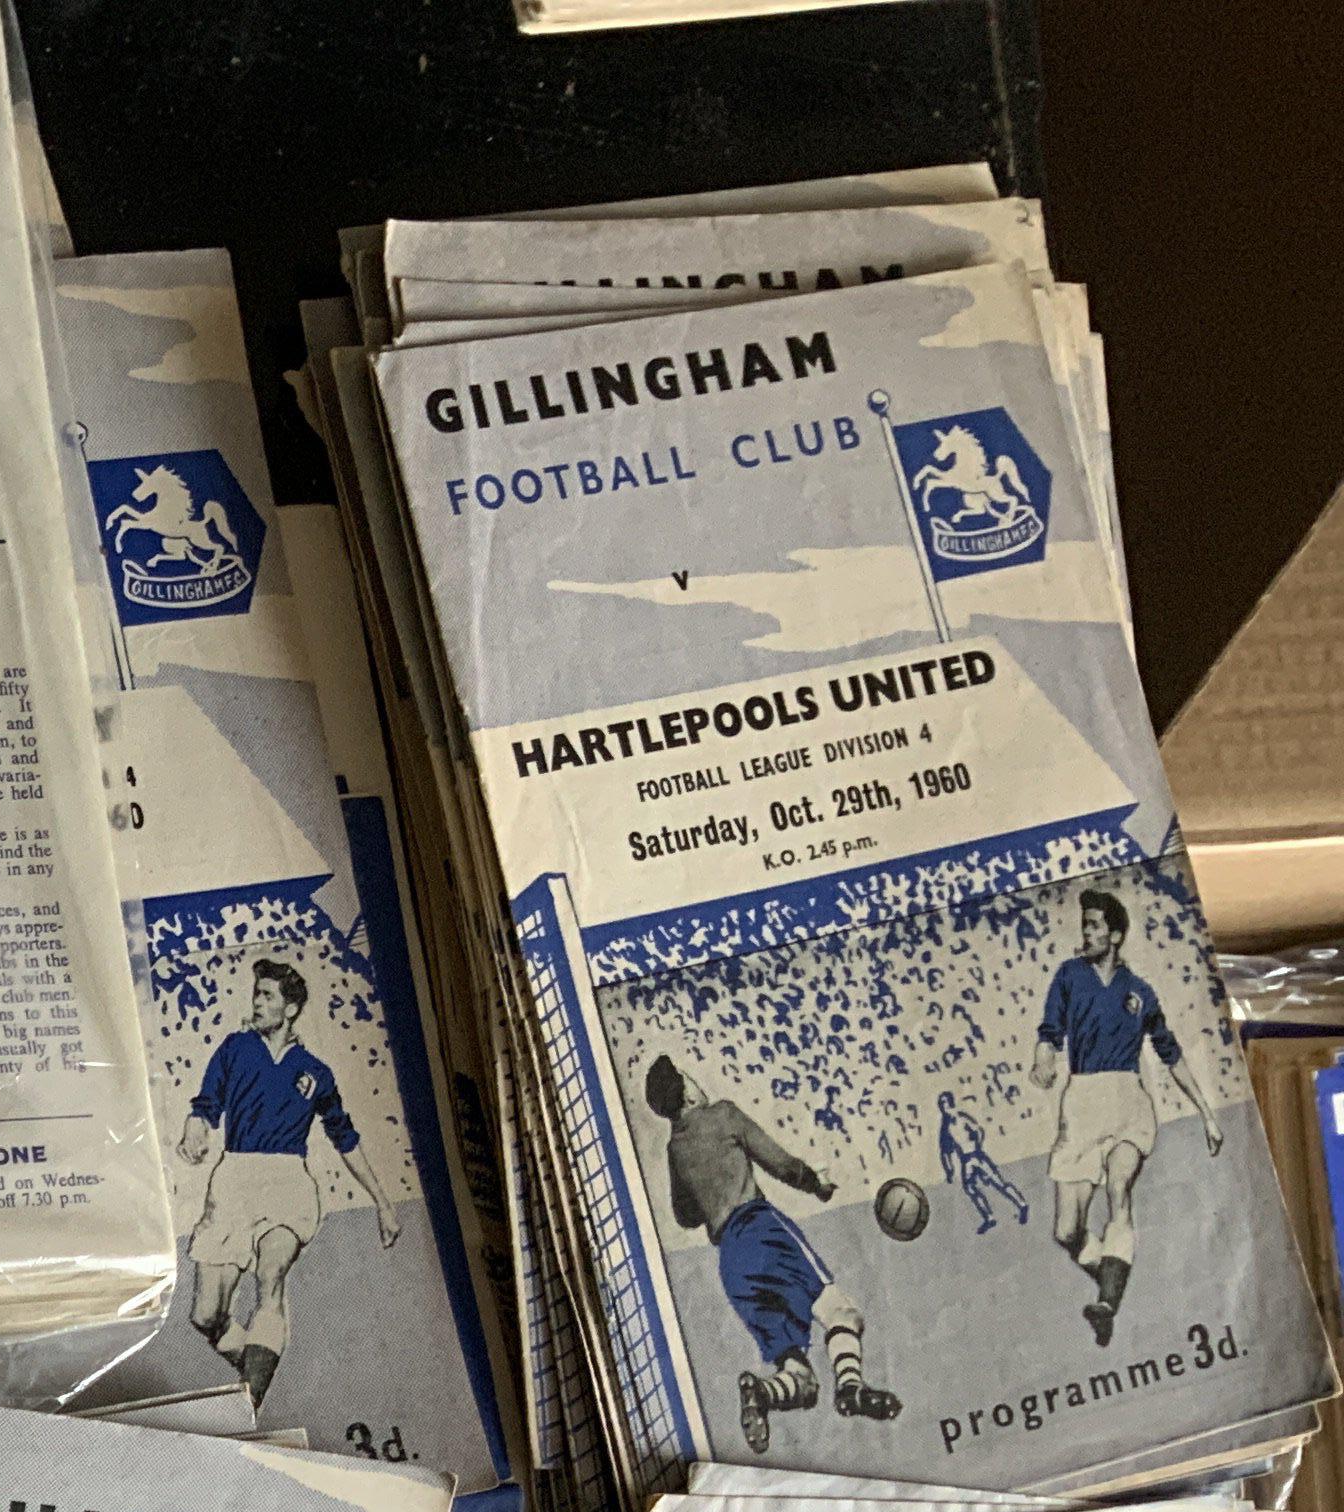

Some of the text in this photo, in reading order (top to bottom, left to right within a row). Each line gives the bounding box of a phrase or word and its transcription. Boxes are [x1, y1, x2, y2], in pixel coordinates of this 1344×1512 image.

[425, 331, 838, 435] GILLINGHAM
[446, 416, 861, 516] FOOTBALL CLUB
[512, 650, 996, 778] HARTLEPOOLS UNITED
[628, 762, 972, 862] Saturday, Oct. 29th, 1960
[637, 728, 909, 802] FOOTBALL LEAGUE DIVISION
[762, 833, 879, 870] K.O. p.m.
[939, 1322, 1248, 1455] programme 3d.
[344, 1422, 420, 1464] 3d.
